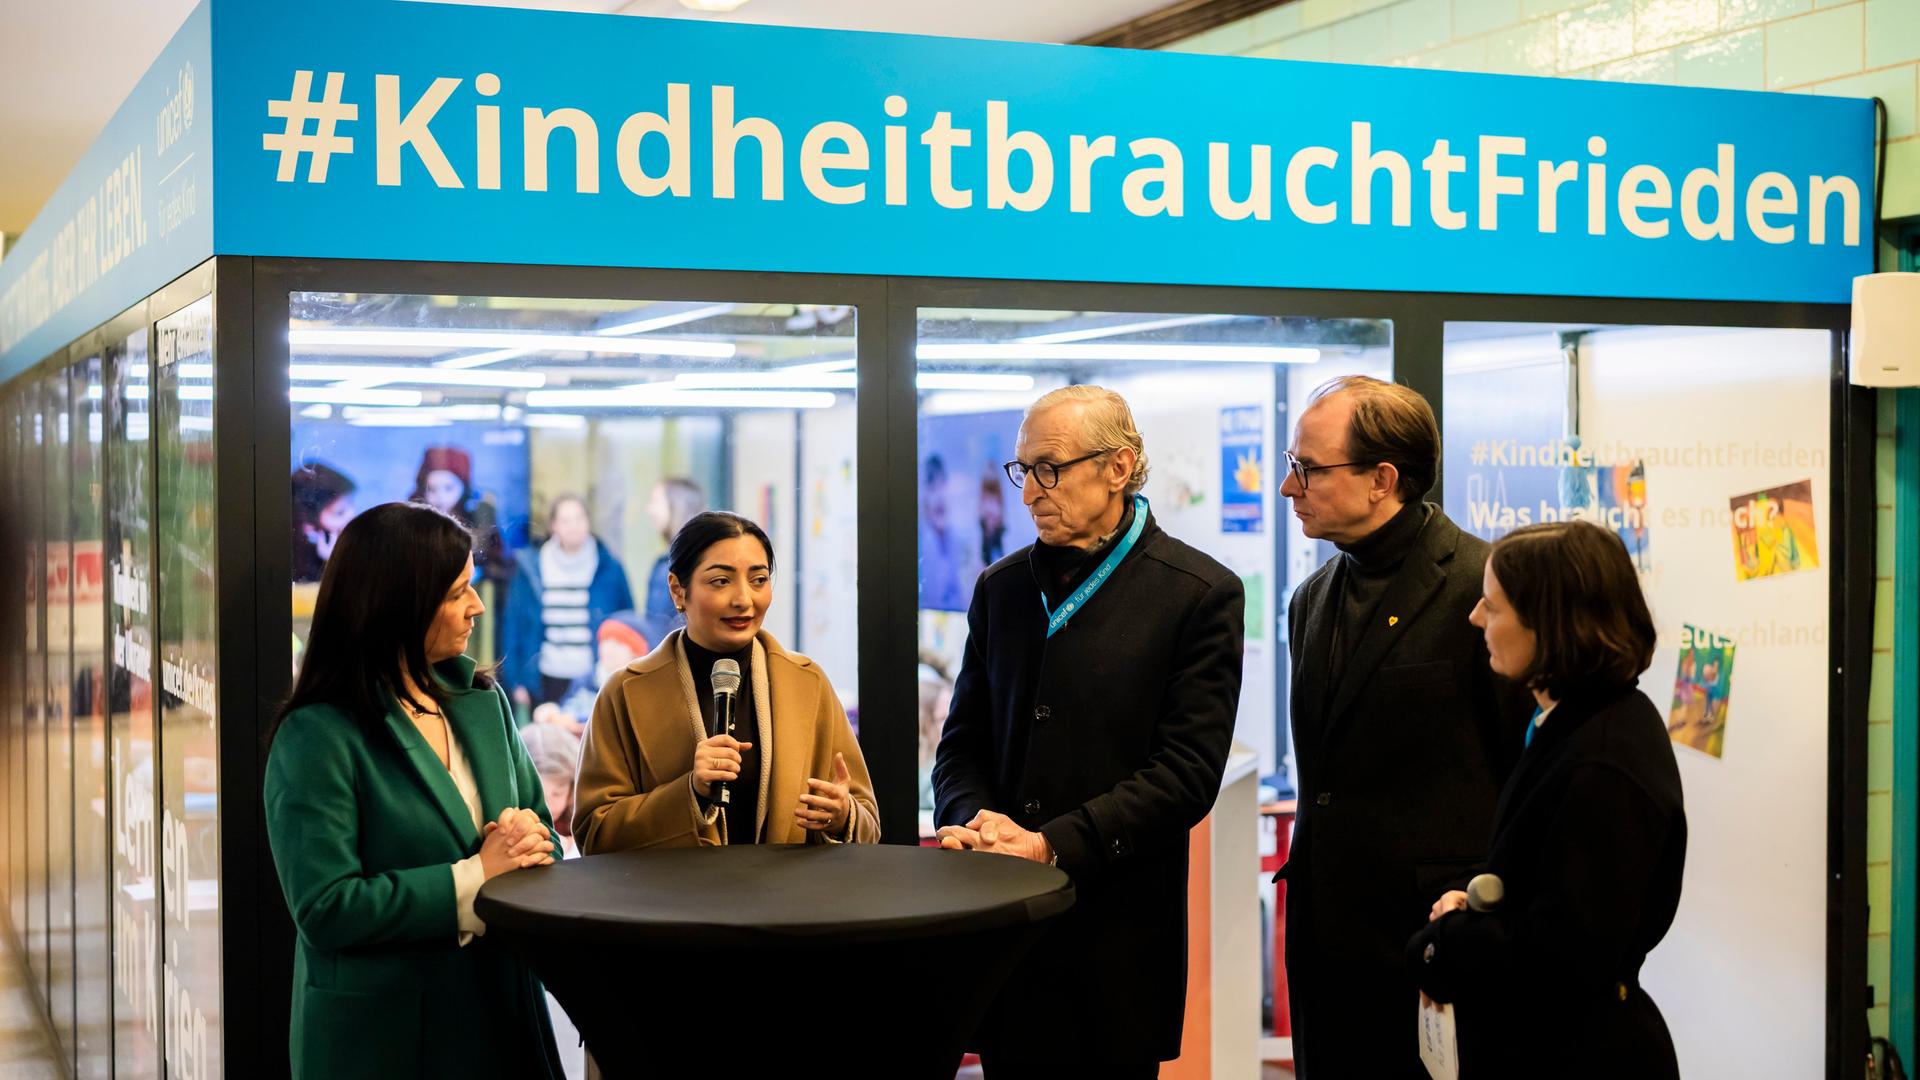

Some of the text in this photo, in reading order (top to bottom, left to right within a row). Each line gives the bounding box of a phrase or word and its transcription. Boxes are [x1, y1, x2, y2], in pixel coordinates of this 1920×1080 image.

[263, 68, 1860, 247] #KindheitbrauchtFrieden
[100, 143, 147, 276] LEBEN.
[1471, 437, 1825, 469] #KindheitbrauchtFrieden
[1471, 499, 1532, 530] Was
[1662, 505, 1691, 529] es
[1700, 499, 1780, 530] noch?
[1050, 608, 1069, 628] unicef
[1074, 594, 1085, 605] für
[1098, 562, 1112, 580] Kind
[1667, 617, 1825, 650] eutschland
[117, 869, 140, 1015] im
